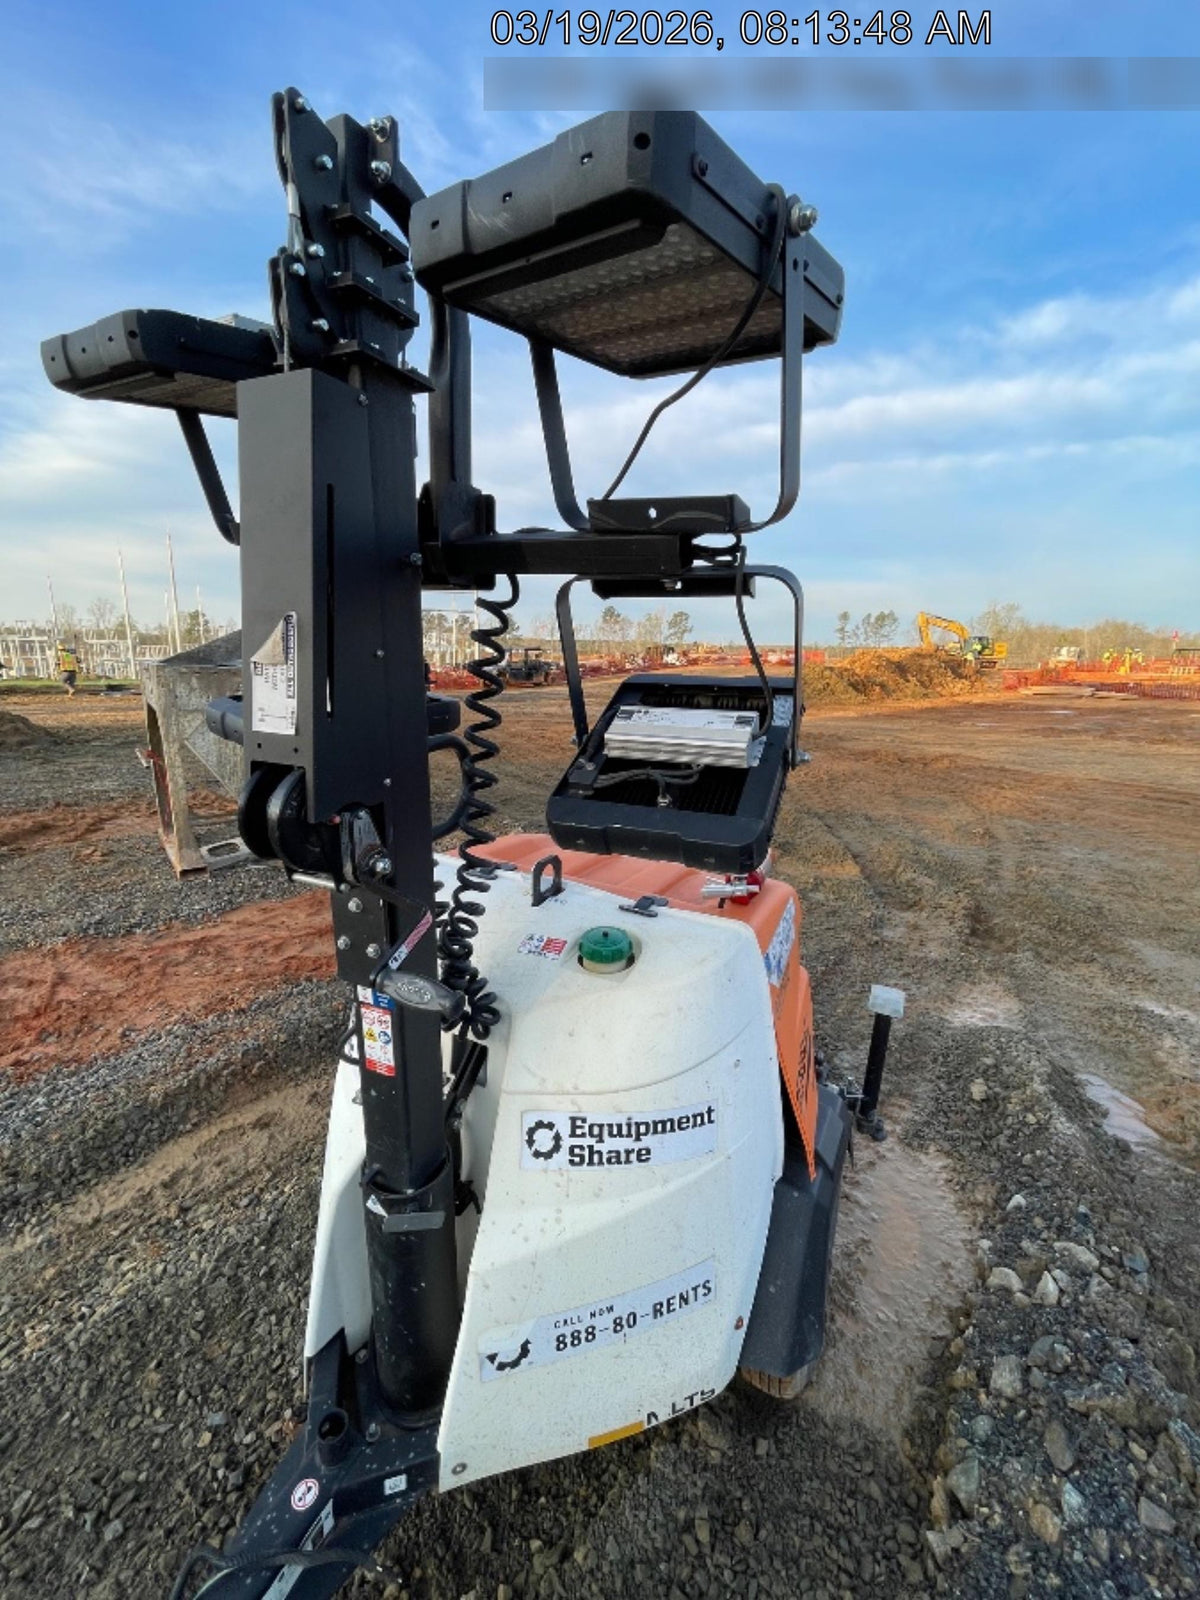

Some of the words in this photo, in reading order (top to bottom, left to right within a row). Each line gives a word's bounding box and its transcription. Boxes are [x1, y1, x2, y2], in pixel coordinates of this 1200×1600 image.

[568, 1105, 715, 1144] Equipment
[568, 1144, 651, 1168] Share
[554, 1314, 583, 1329] CALL
[589, 1304, 615, 1321] NOW
